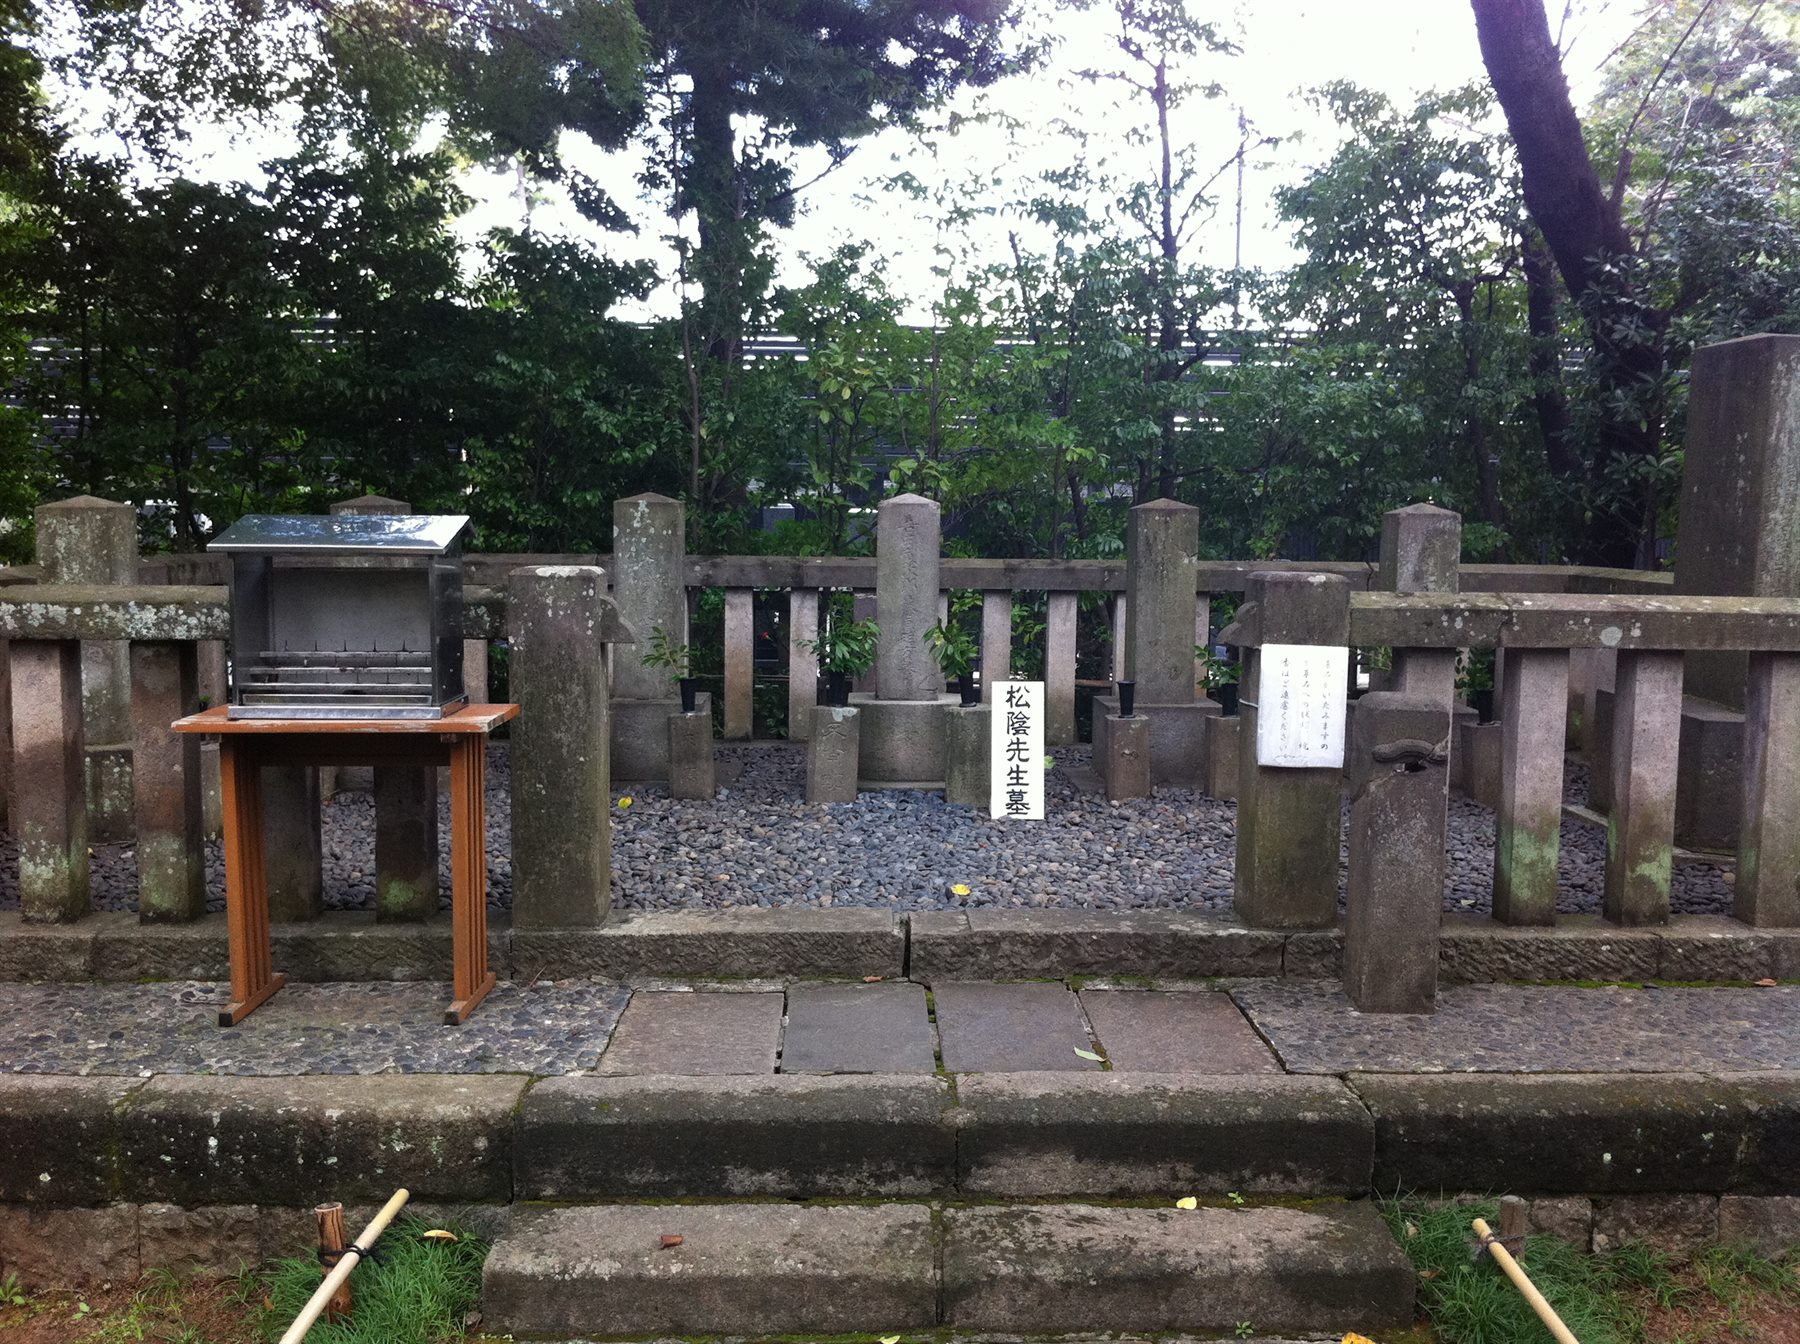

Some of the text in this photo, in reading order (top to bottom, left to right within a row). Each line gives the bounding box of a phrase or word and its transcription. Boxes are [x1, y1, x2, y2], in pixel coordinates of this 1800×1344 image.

[1005, 684, 1031, 816] 松陰先生墓
